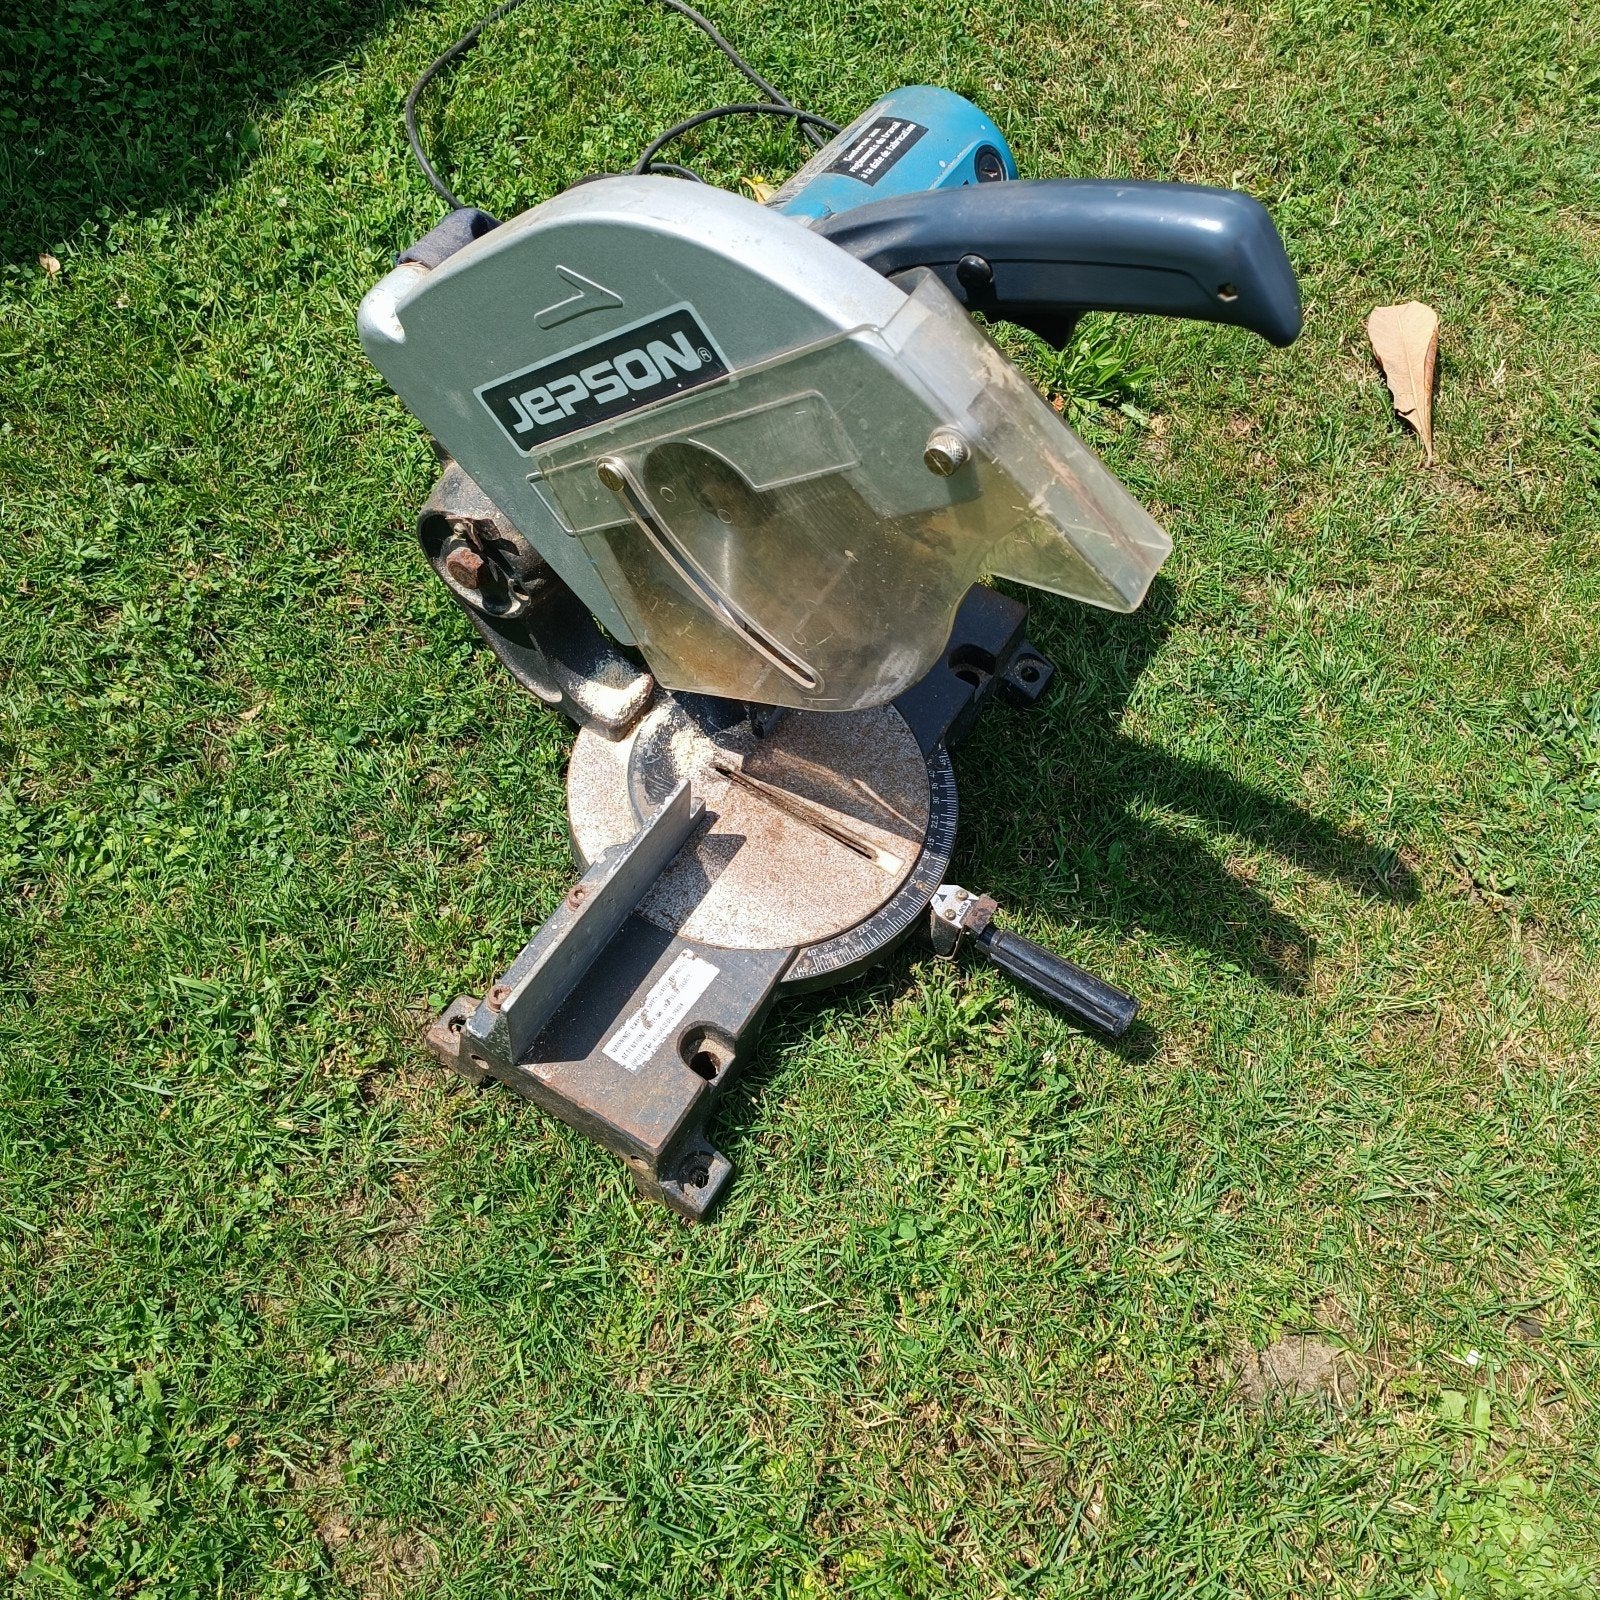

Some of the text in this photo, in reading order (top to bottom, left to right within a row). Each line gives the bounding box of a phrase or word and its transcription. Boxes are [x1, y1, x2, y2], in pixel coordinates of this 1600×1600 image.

[881, 122, 901, 138] travail
[869, 156, 885, 170] date
[881, 149, 891, 158] de
[886, 123, 916, 151] fabrication
[956, 901, 969, 917] LOCK
